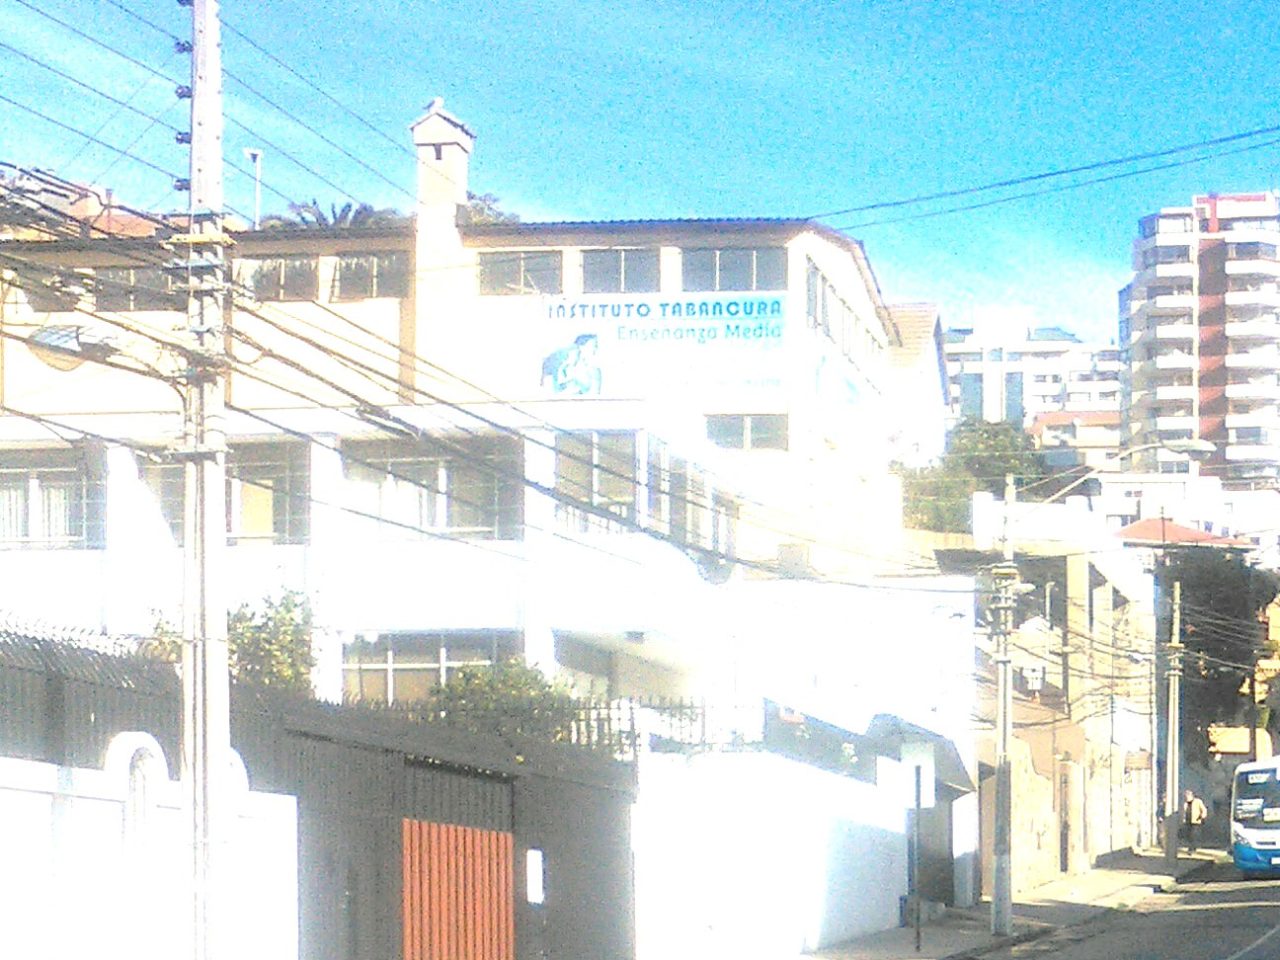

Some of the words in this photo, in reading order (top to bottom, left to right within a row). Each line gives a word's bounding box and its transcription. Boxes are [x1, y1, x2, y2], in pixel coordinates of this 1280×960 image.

[549, 303, 651, 318] INSTITUTO
[660, 300, 782, 317] TABANCURA
[725, 322, 781, 339] Media
